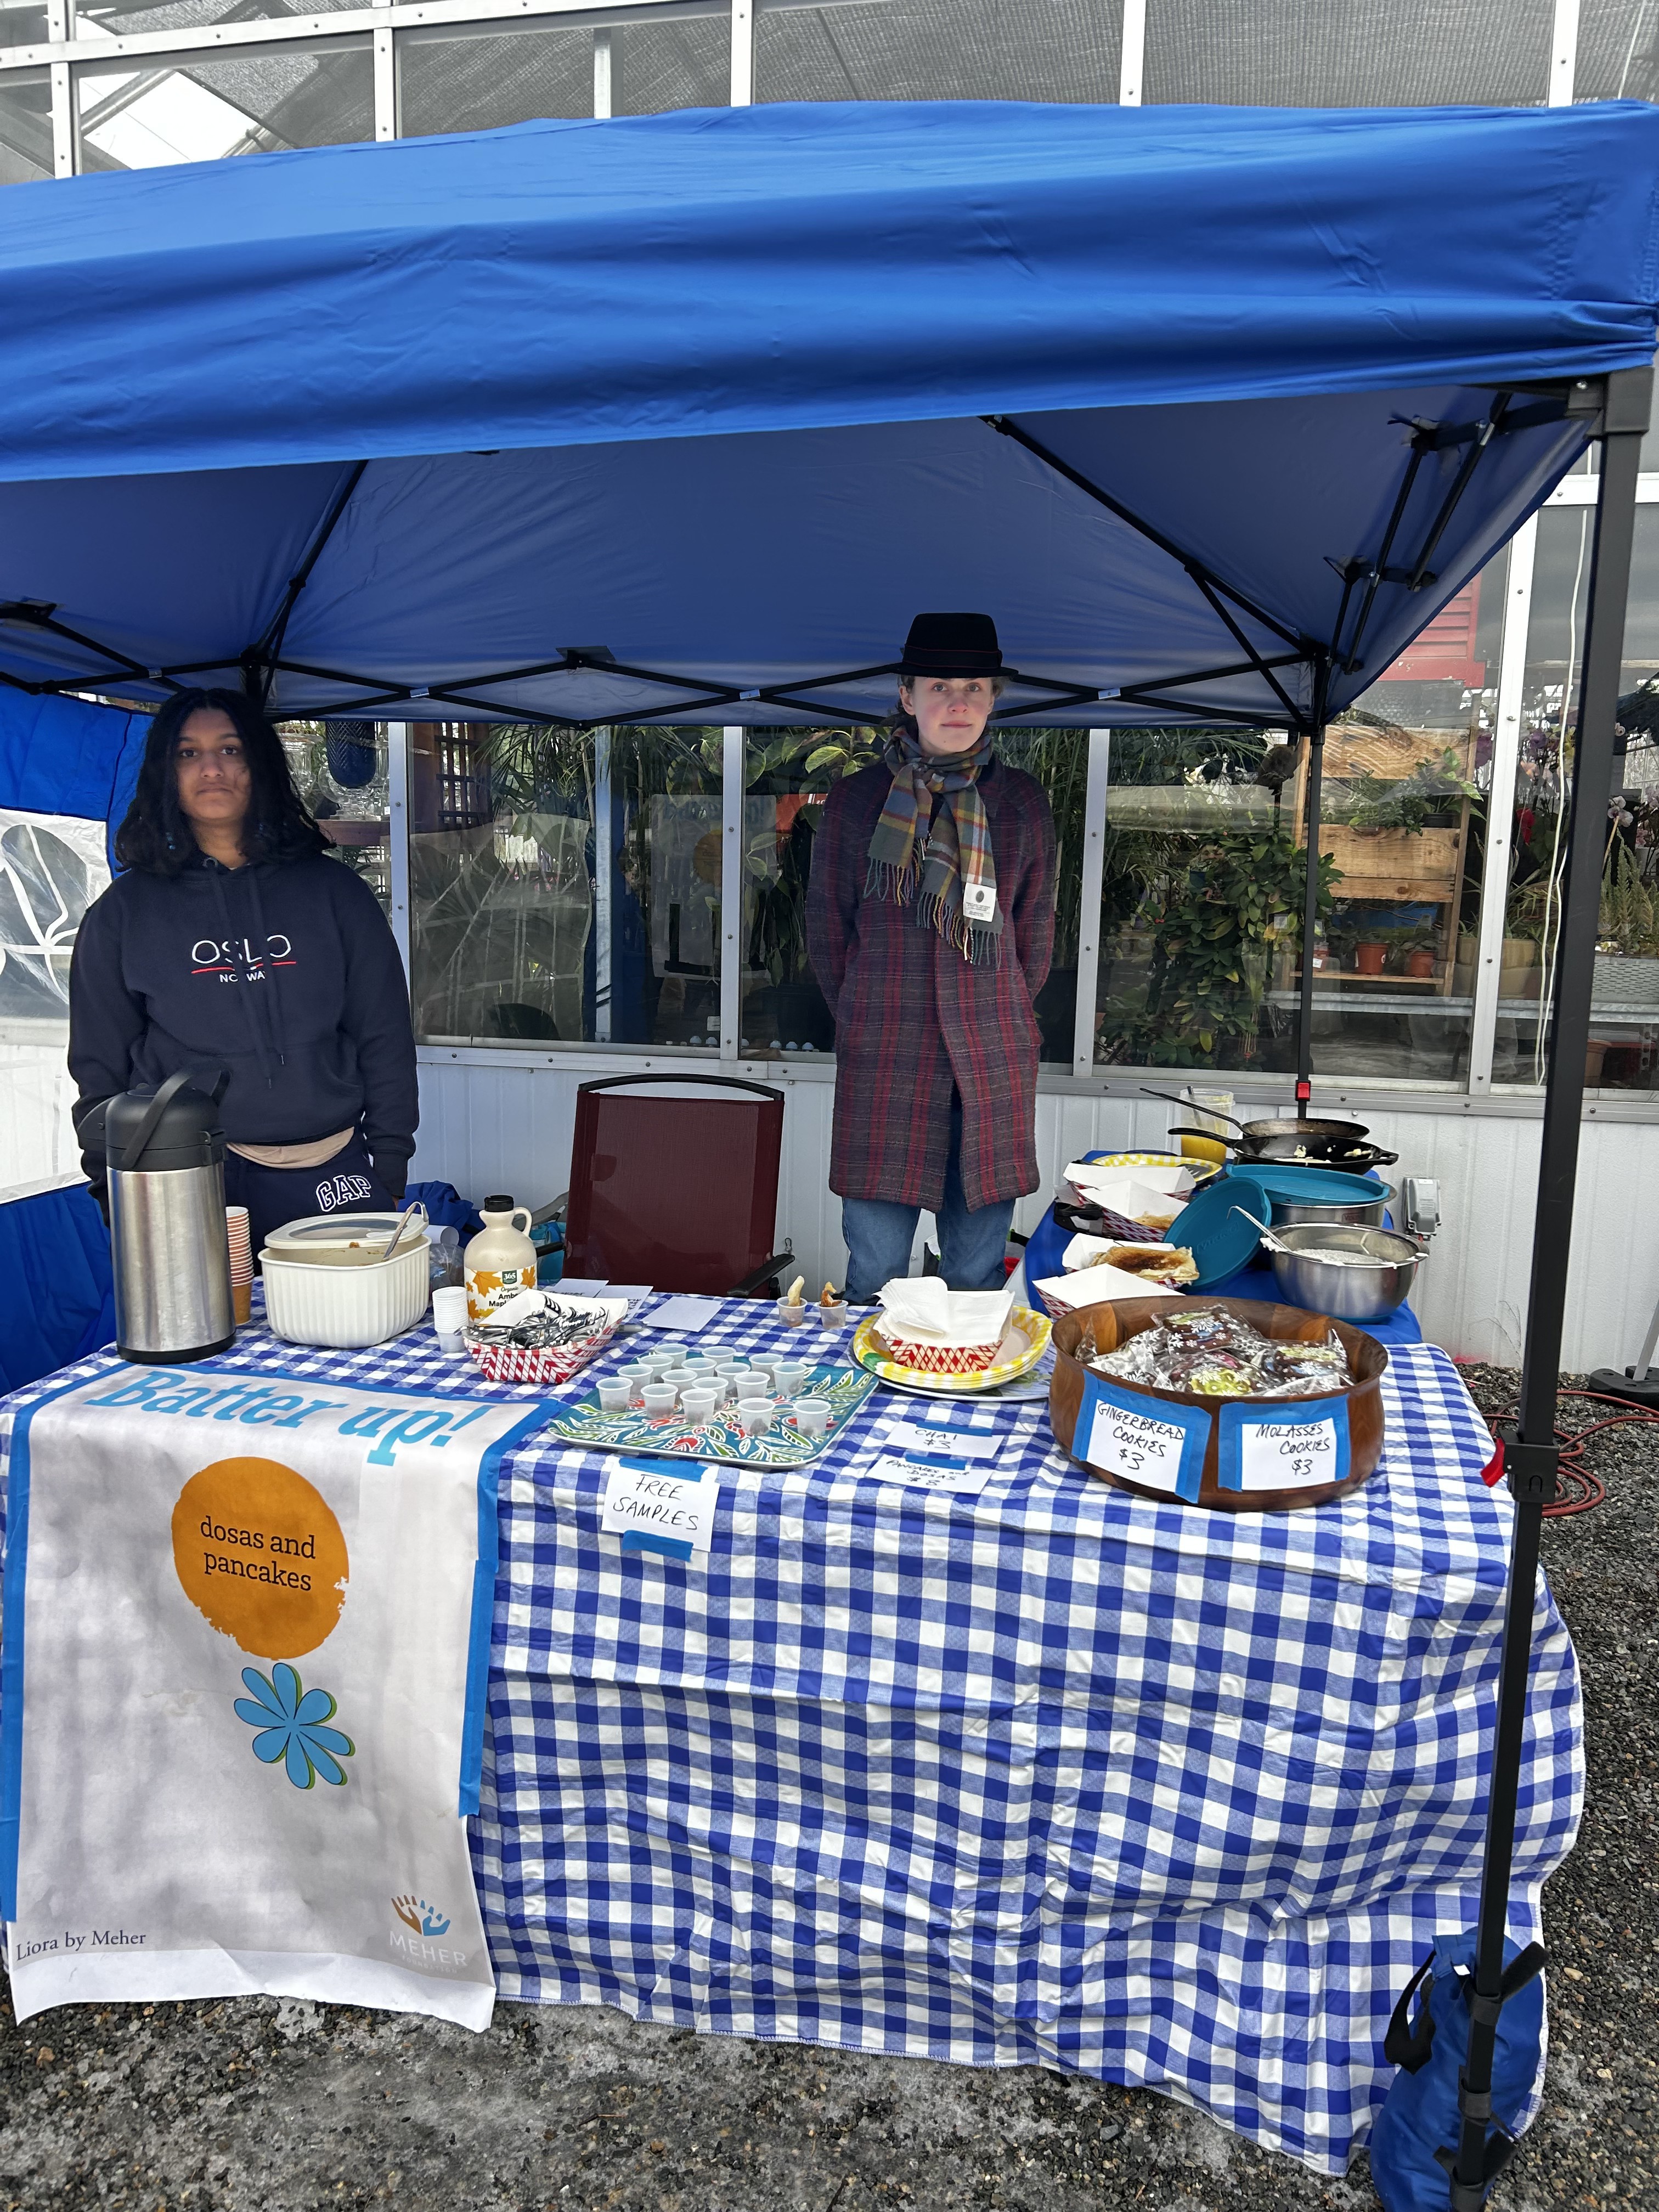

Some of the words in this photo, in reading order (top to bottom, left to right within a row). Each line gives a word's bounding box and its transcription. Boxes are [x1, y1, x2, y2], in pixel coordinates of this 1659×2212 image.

[191, 934, 292, 964] OSLO
[315, 1175, 371, 1212] GAP
[84, 1370, 347, 1427] Batter
[337, 1401, 498, 1466] up!
[1098, 1402, 1184, 1440] GINGERBREAD
[1255, 1423, 1323, 1438] MOLASSES
[915, 1429, 957, 1441] CHAI
[1113, 1426, 1166, 1457] COOKIES
[1279, 1437, 1330, 1455] COOKIES
[1119, 1448, 1145, 1470] $3
[1291, 1458, 1313, 1476] $3
[636, 1474, 684, 1501] FREE
[613, 1497, 699, 1531] SAMPLES
[200, 1515, 264, 1549] dosas
[270, 1534, 317, 1560] and
[203, 1551, 312, 1592] pancakes
[16, 1941, 59, 1961] Liora
[65, 1931, 86, 1952] by
[90, 1929, 146, 1946] Meher
[390, 1931, 467, 1967] MEHER
